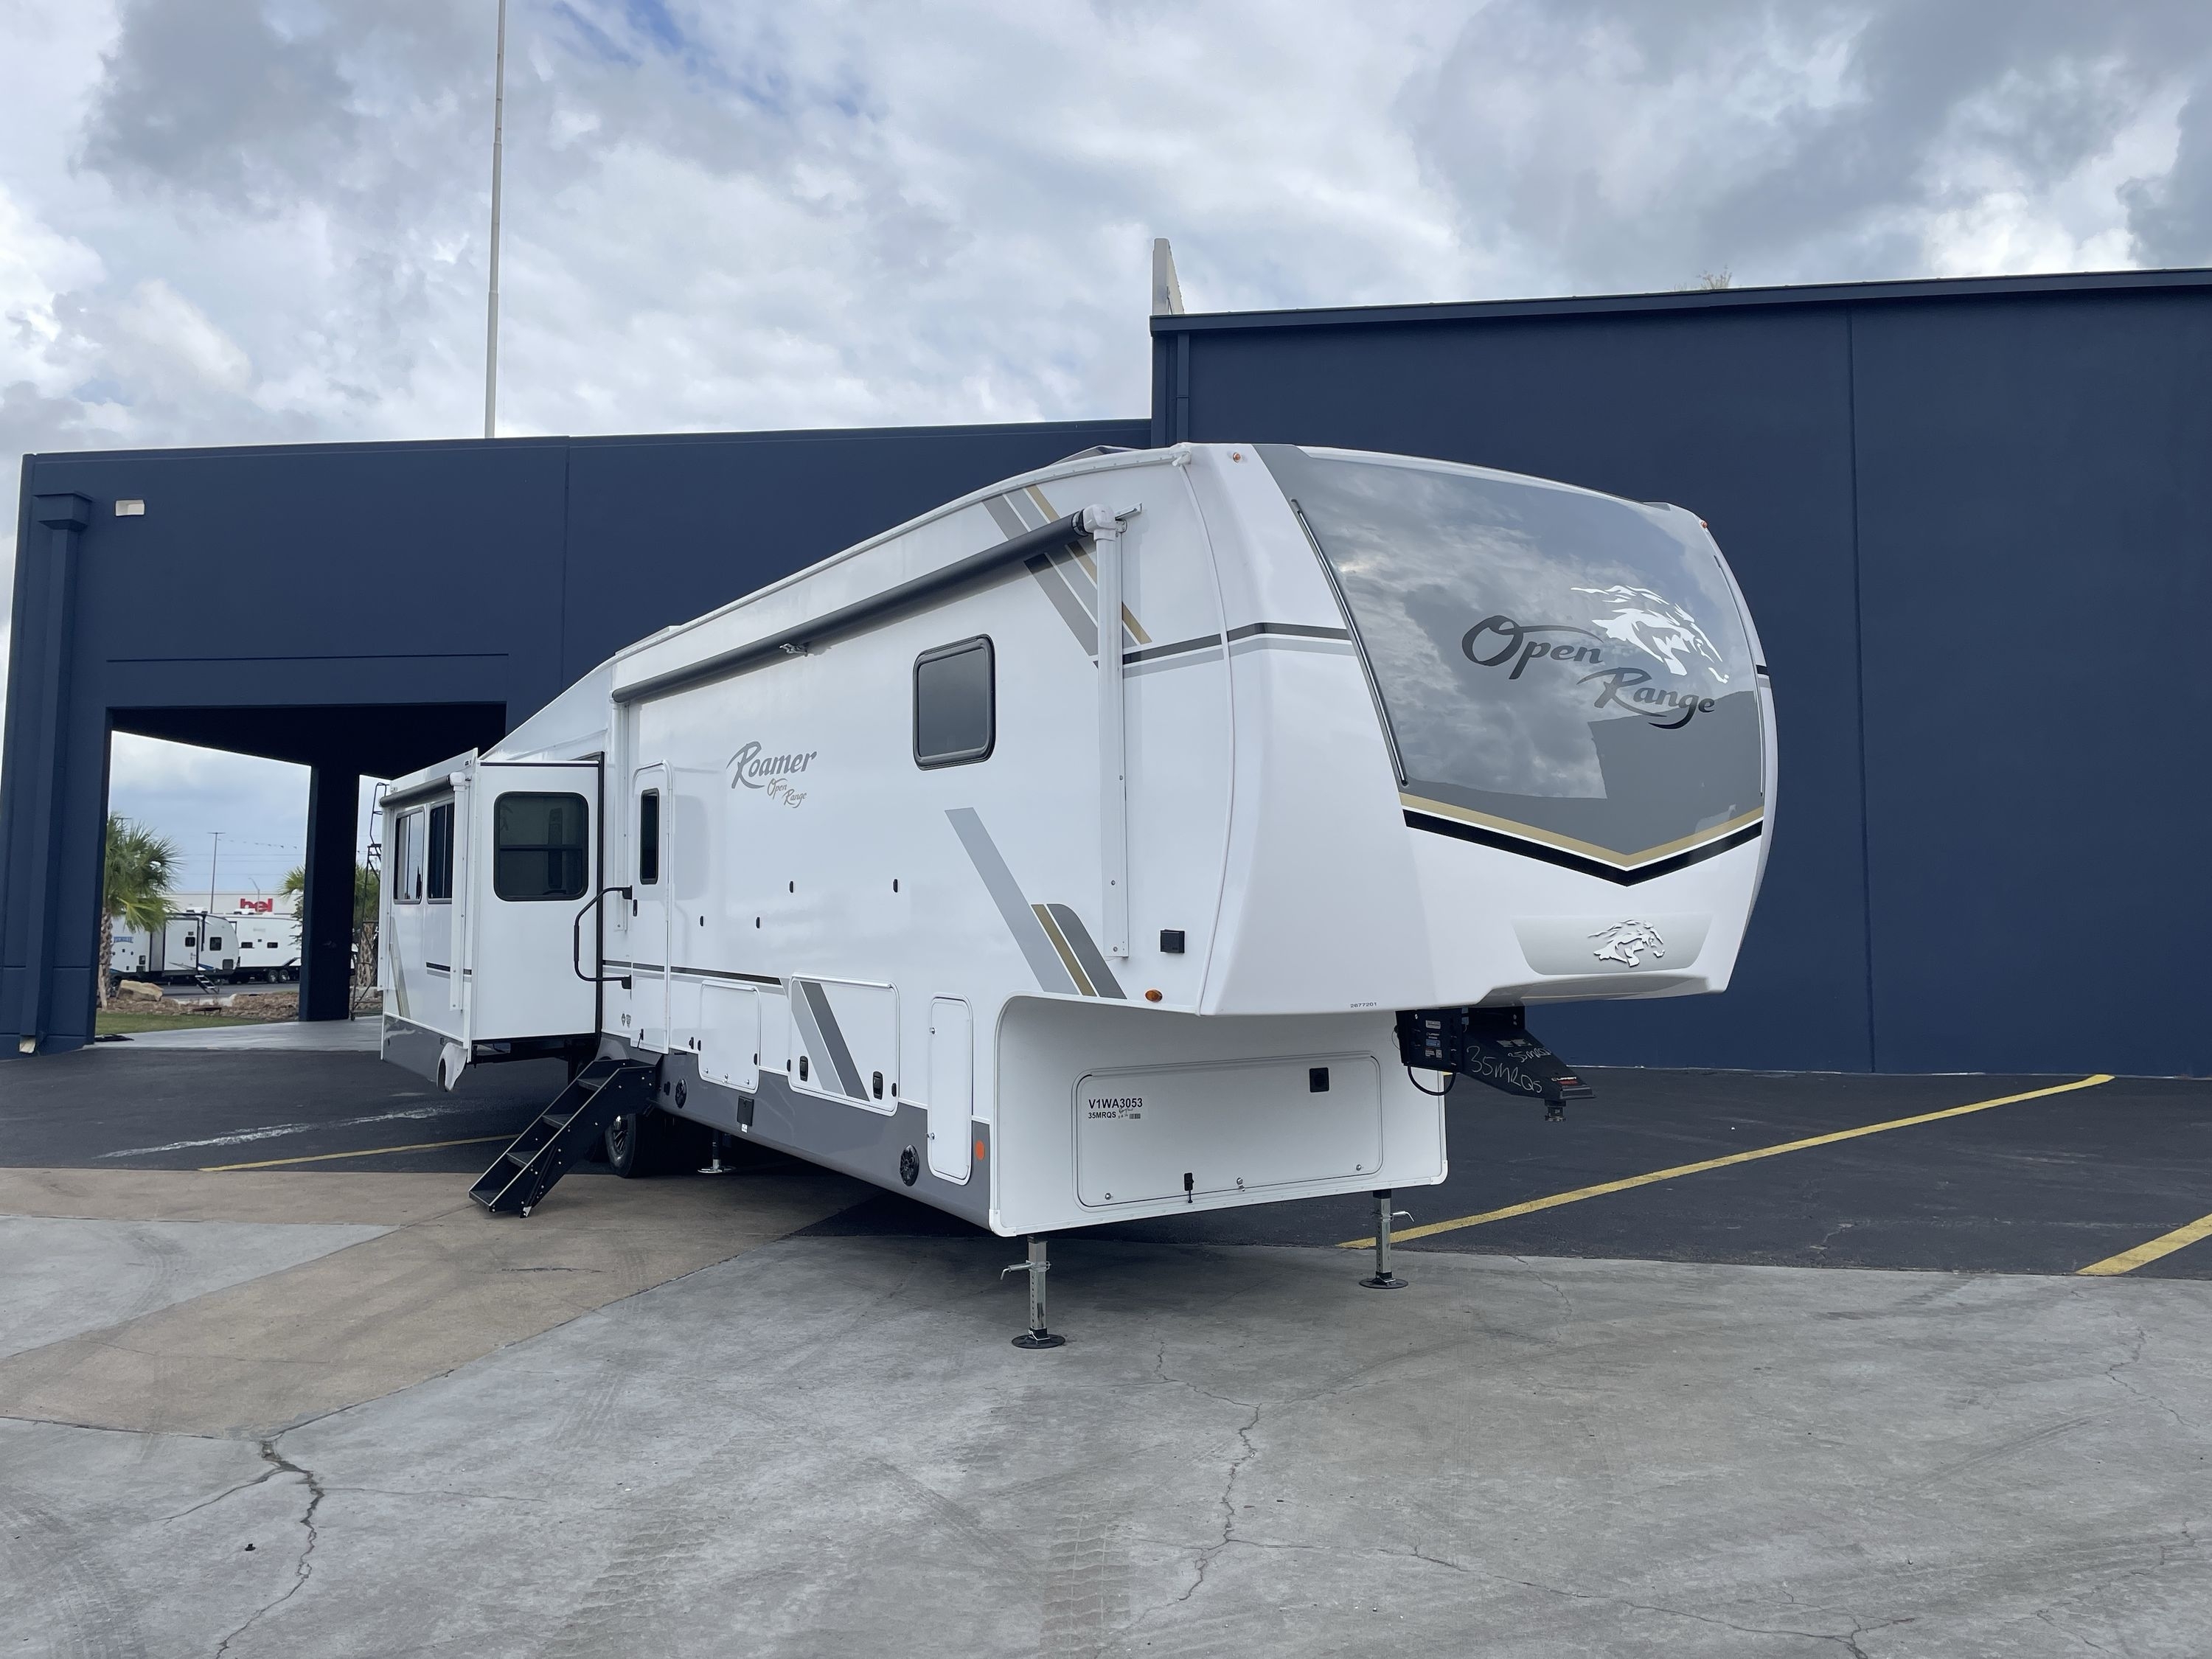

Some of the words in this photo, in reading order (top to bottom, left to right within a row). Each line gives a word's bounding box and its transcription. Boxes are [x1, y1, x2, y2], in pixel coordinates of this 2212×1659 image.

[1462, 615, 1604, 680] Open
[1576, 667, 1715, 730] Range
[726, 741, 817, 789] Roamer
[767, 778, 788, 800] Open
[782, 788, 807, 809] Range
[1088, 1097, 1143, 1109] V1WA3053
[1088, 1111, 1116, 1119] 35MRQS
